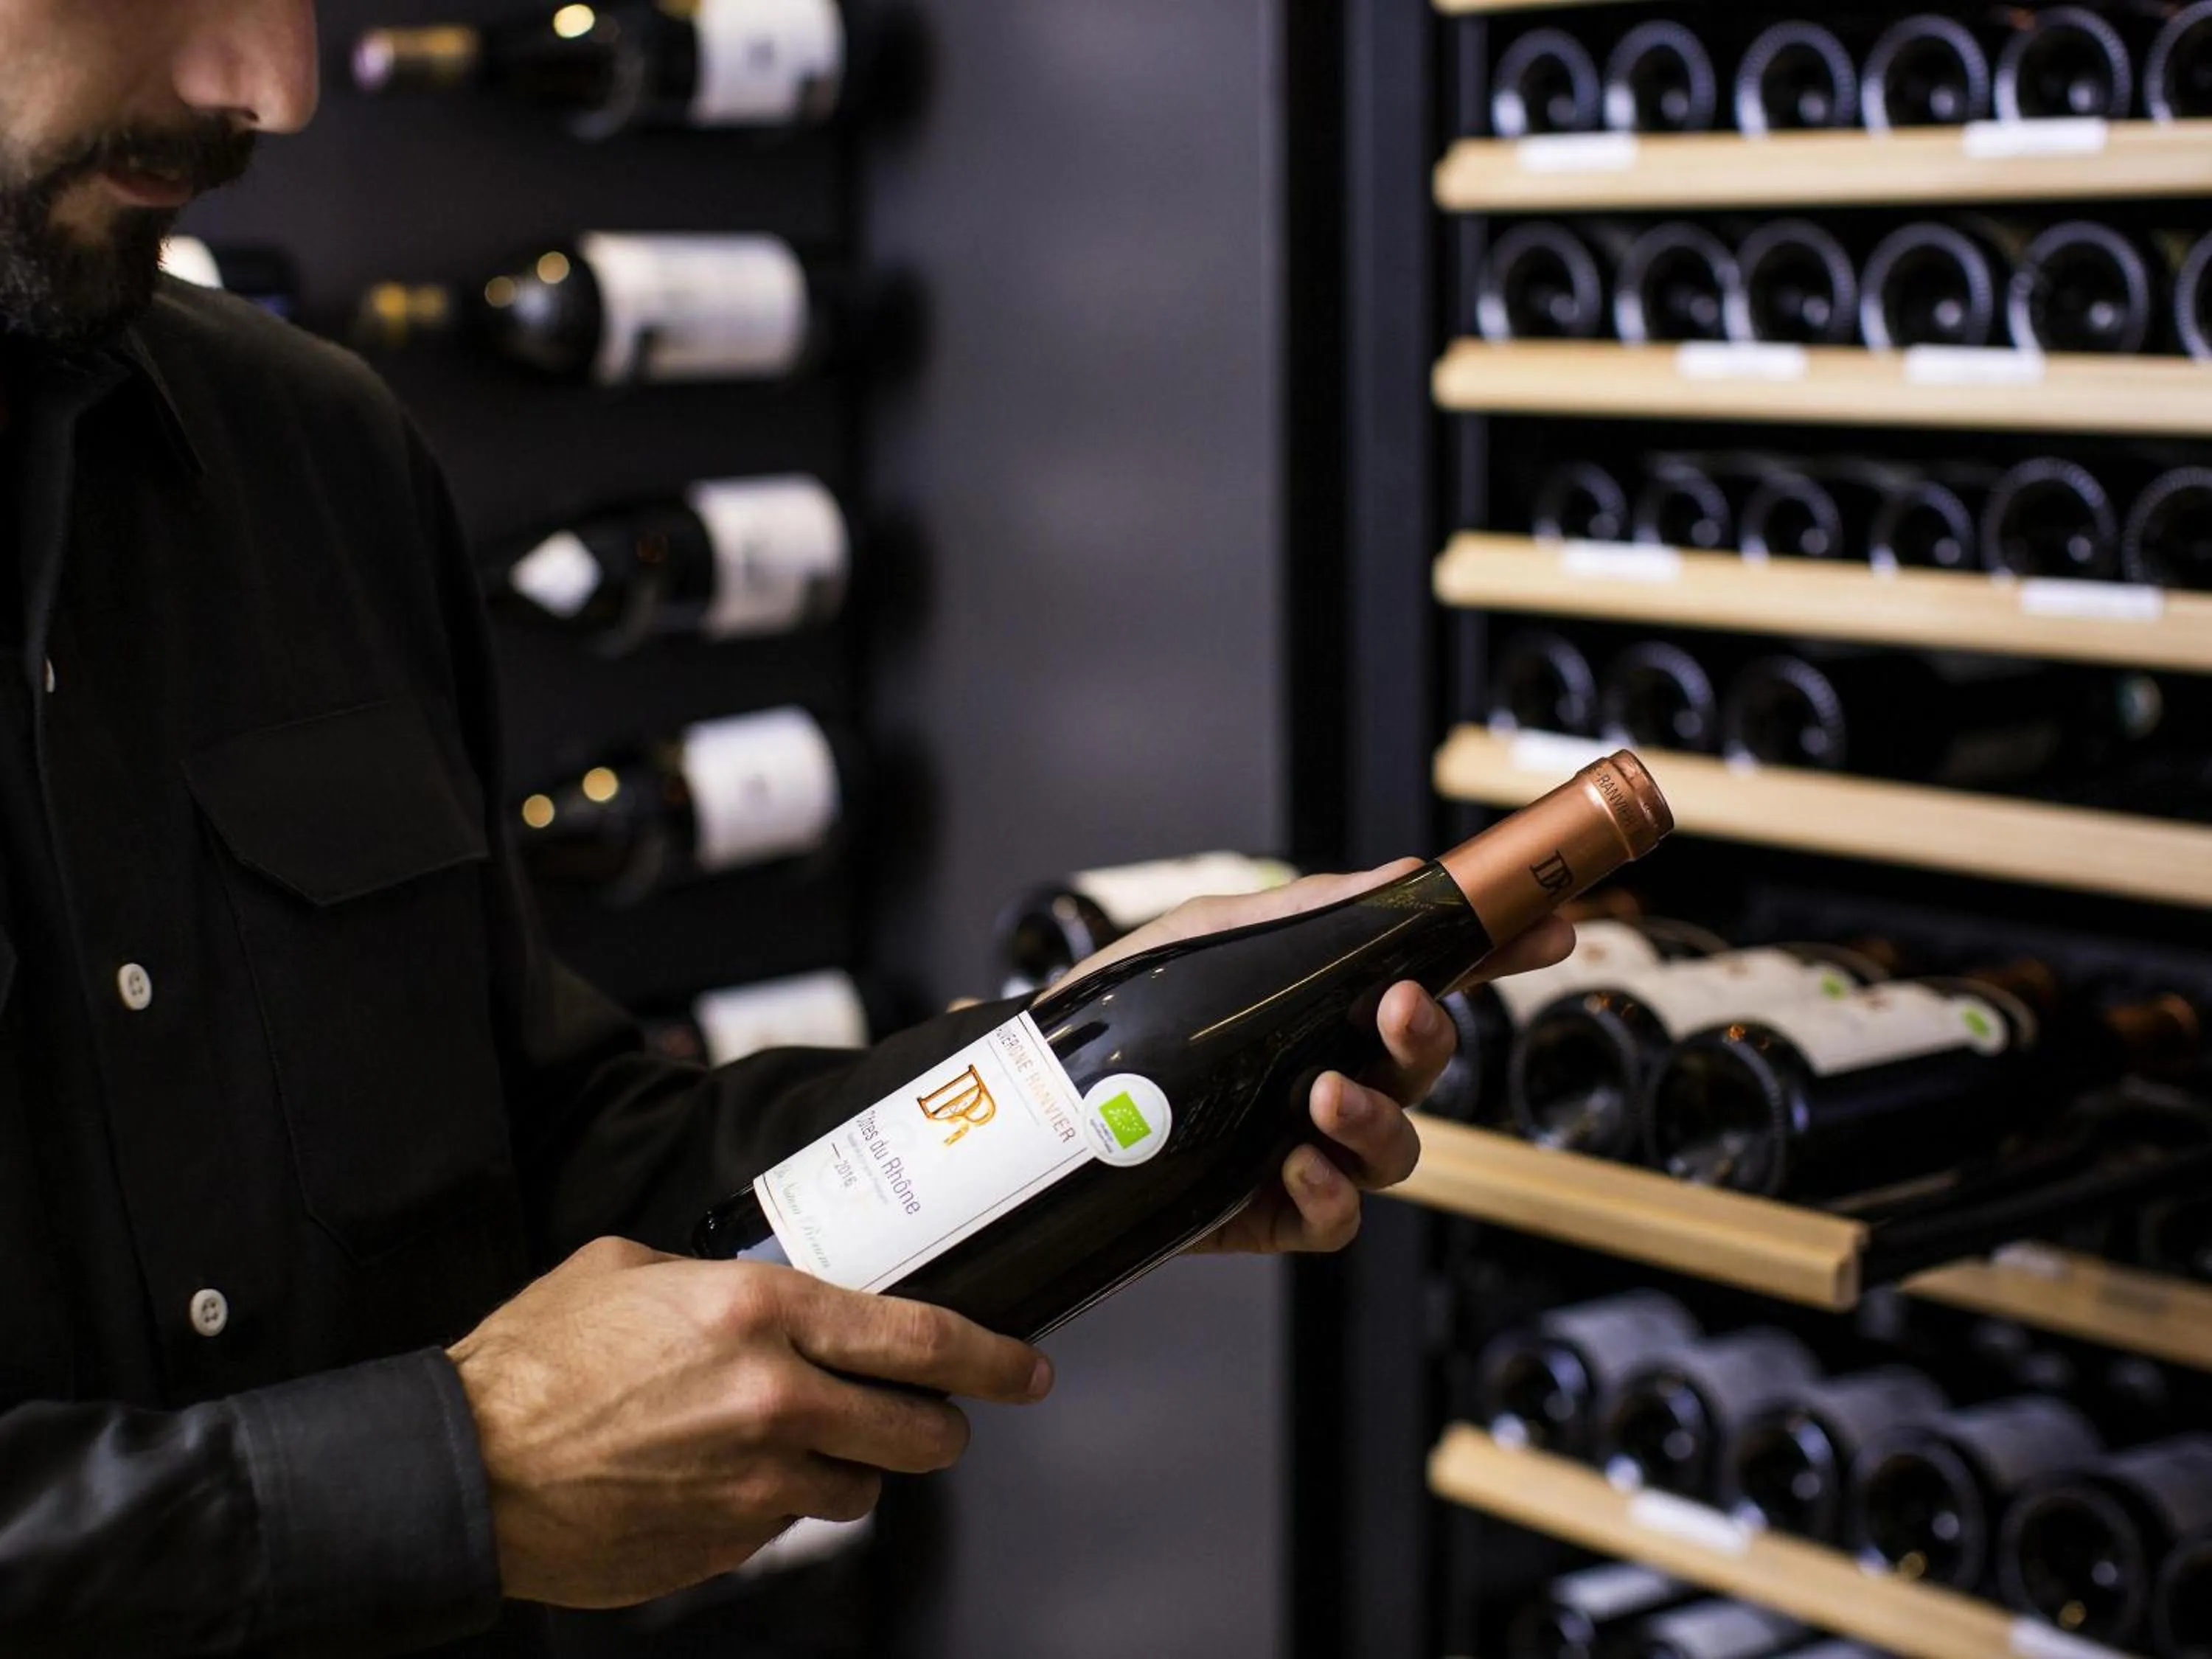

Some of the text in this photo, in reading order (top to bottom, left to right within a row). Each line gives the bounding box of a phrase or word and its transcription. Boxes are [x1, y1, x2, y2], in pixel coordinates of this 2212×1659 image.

[835, 1159, 857, 1188] 2016
[869, 1140, 889, 1160] du
[881, 1156, 921, 1215] Rhône
